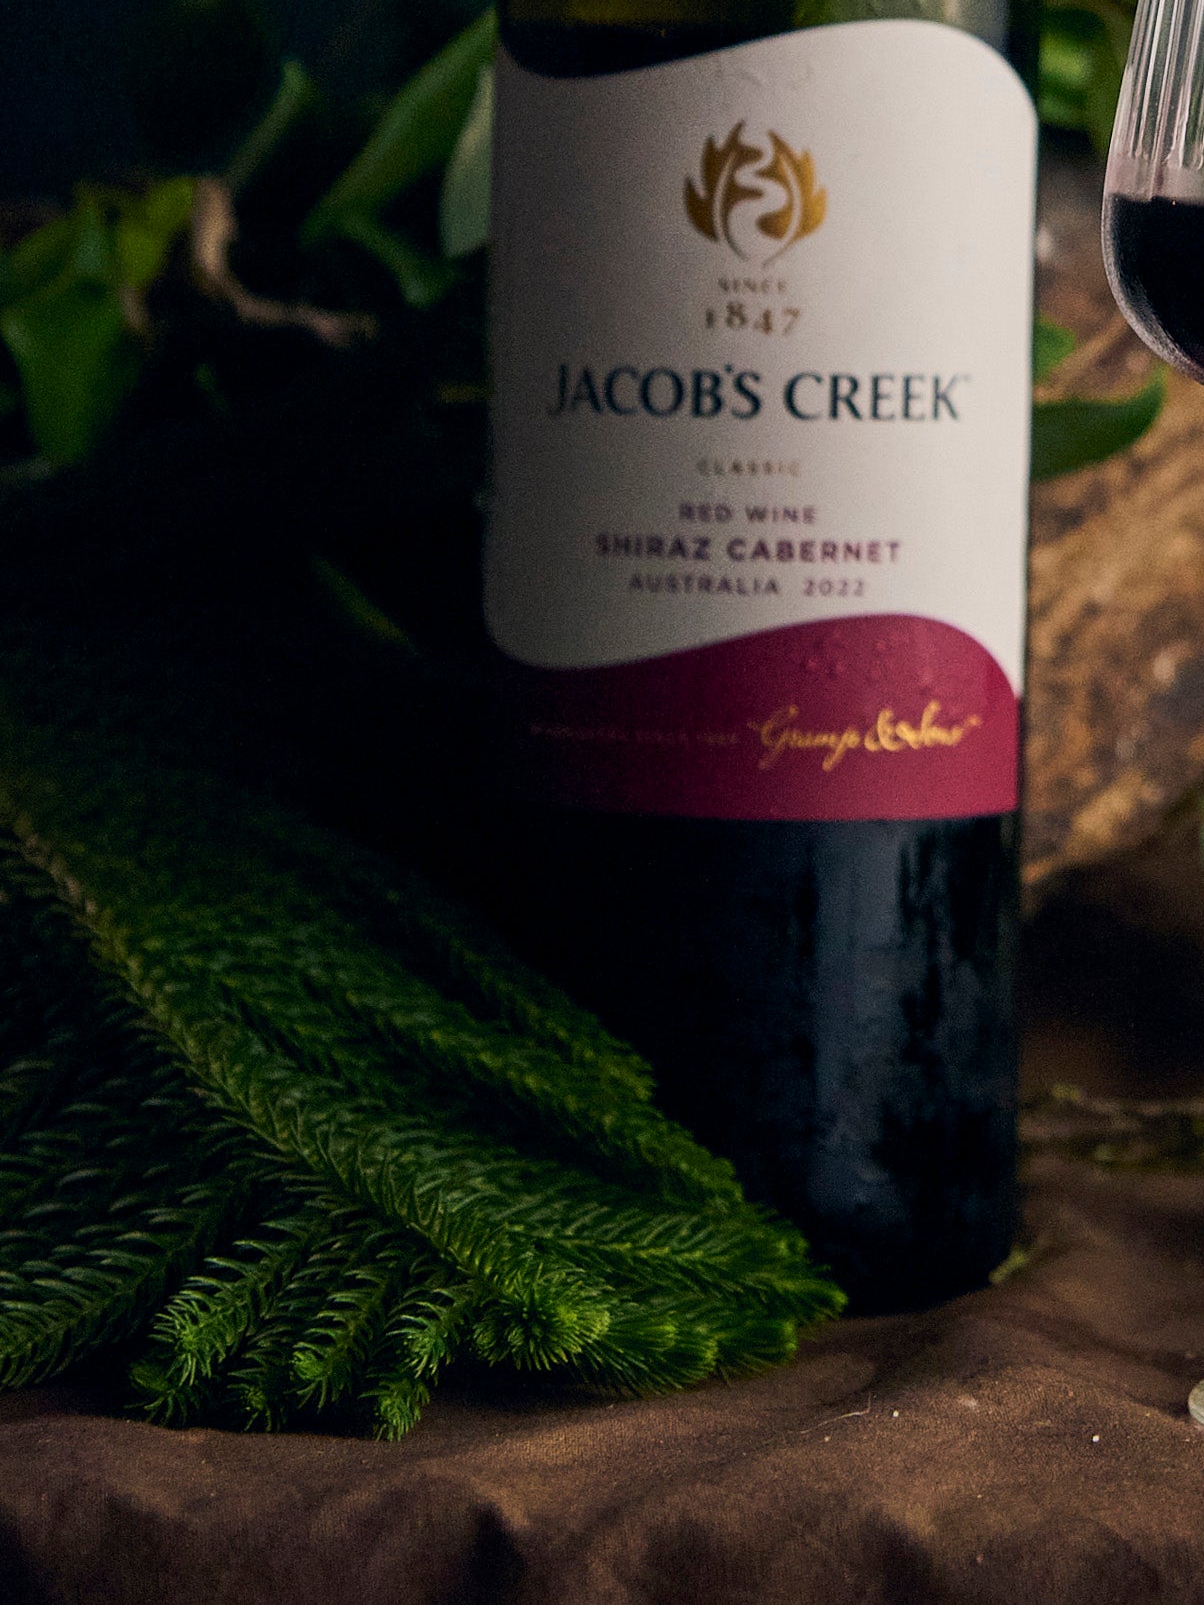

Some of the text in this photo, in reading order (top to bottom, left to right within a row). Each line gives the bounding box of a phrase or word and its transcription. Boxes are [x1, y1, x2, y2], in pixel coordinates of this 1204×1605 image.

[705, 300, 801, 336] 1847
[549, 363, 963, 422] JACOB'S CREEK
[695, 458, 802, 477] CLASSIC
[678, 502, 818, 525] RED WINE
[595, 532, 902, 564] SHIRAZ CABERNET
[628, 573, 866, 597] AUSTRALIA 2022
